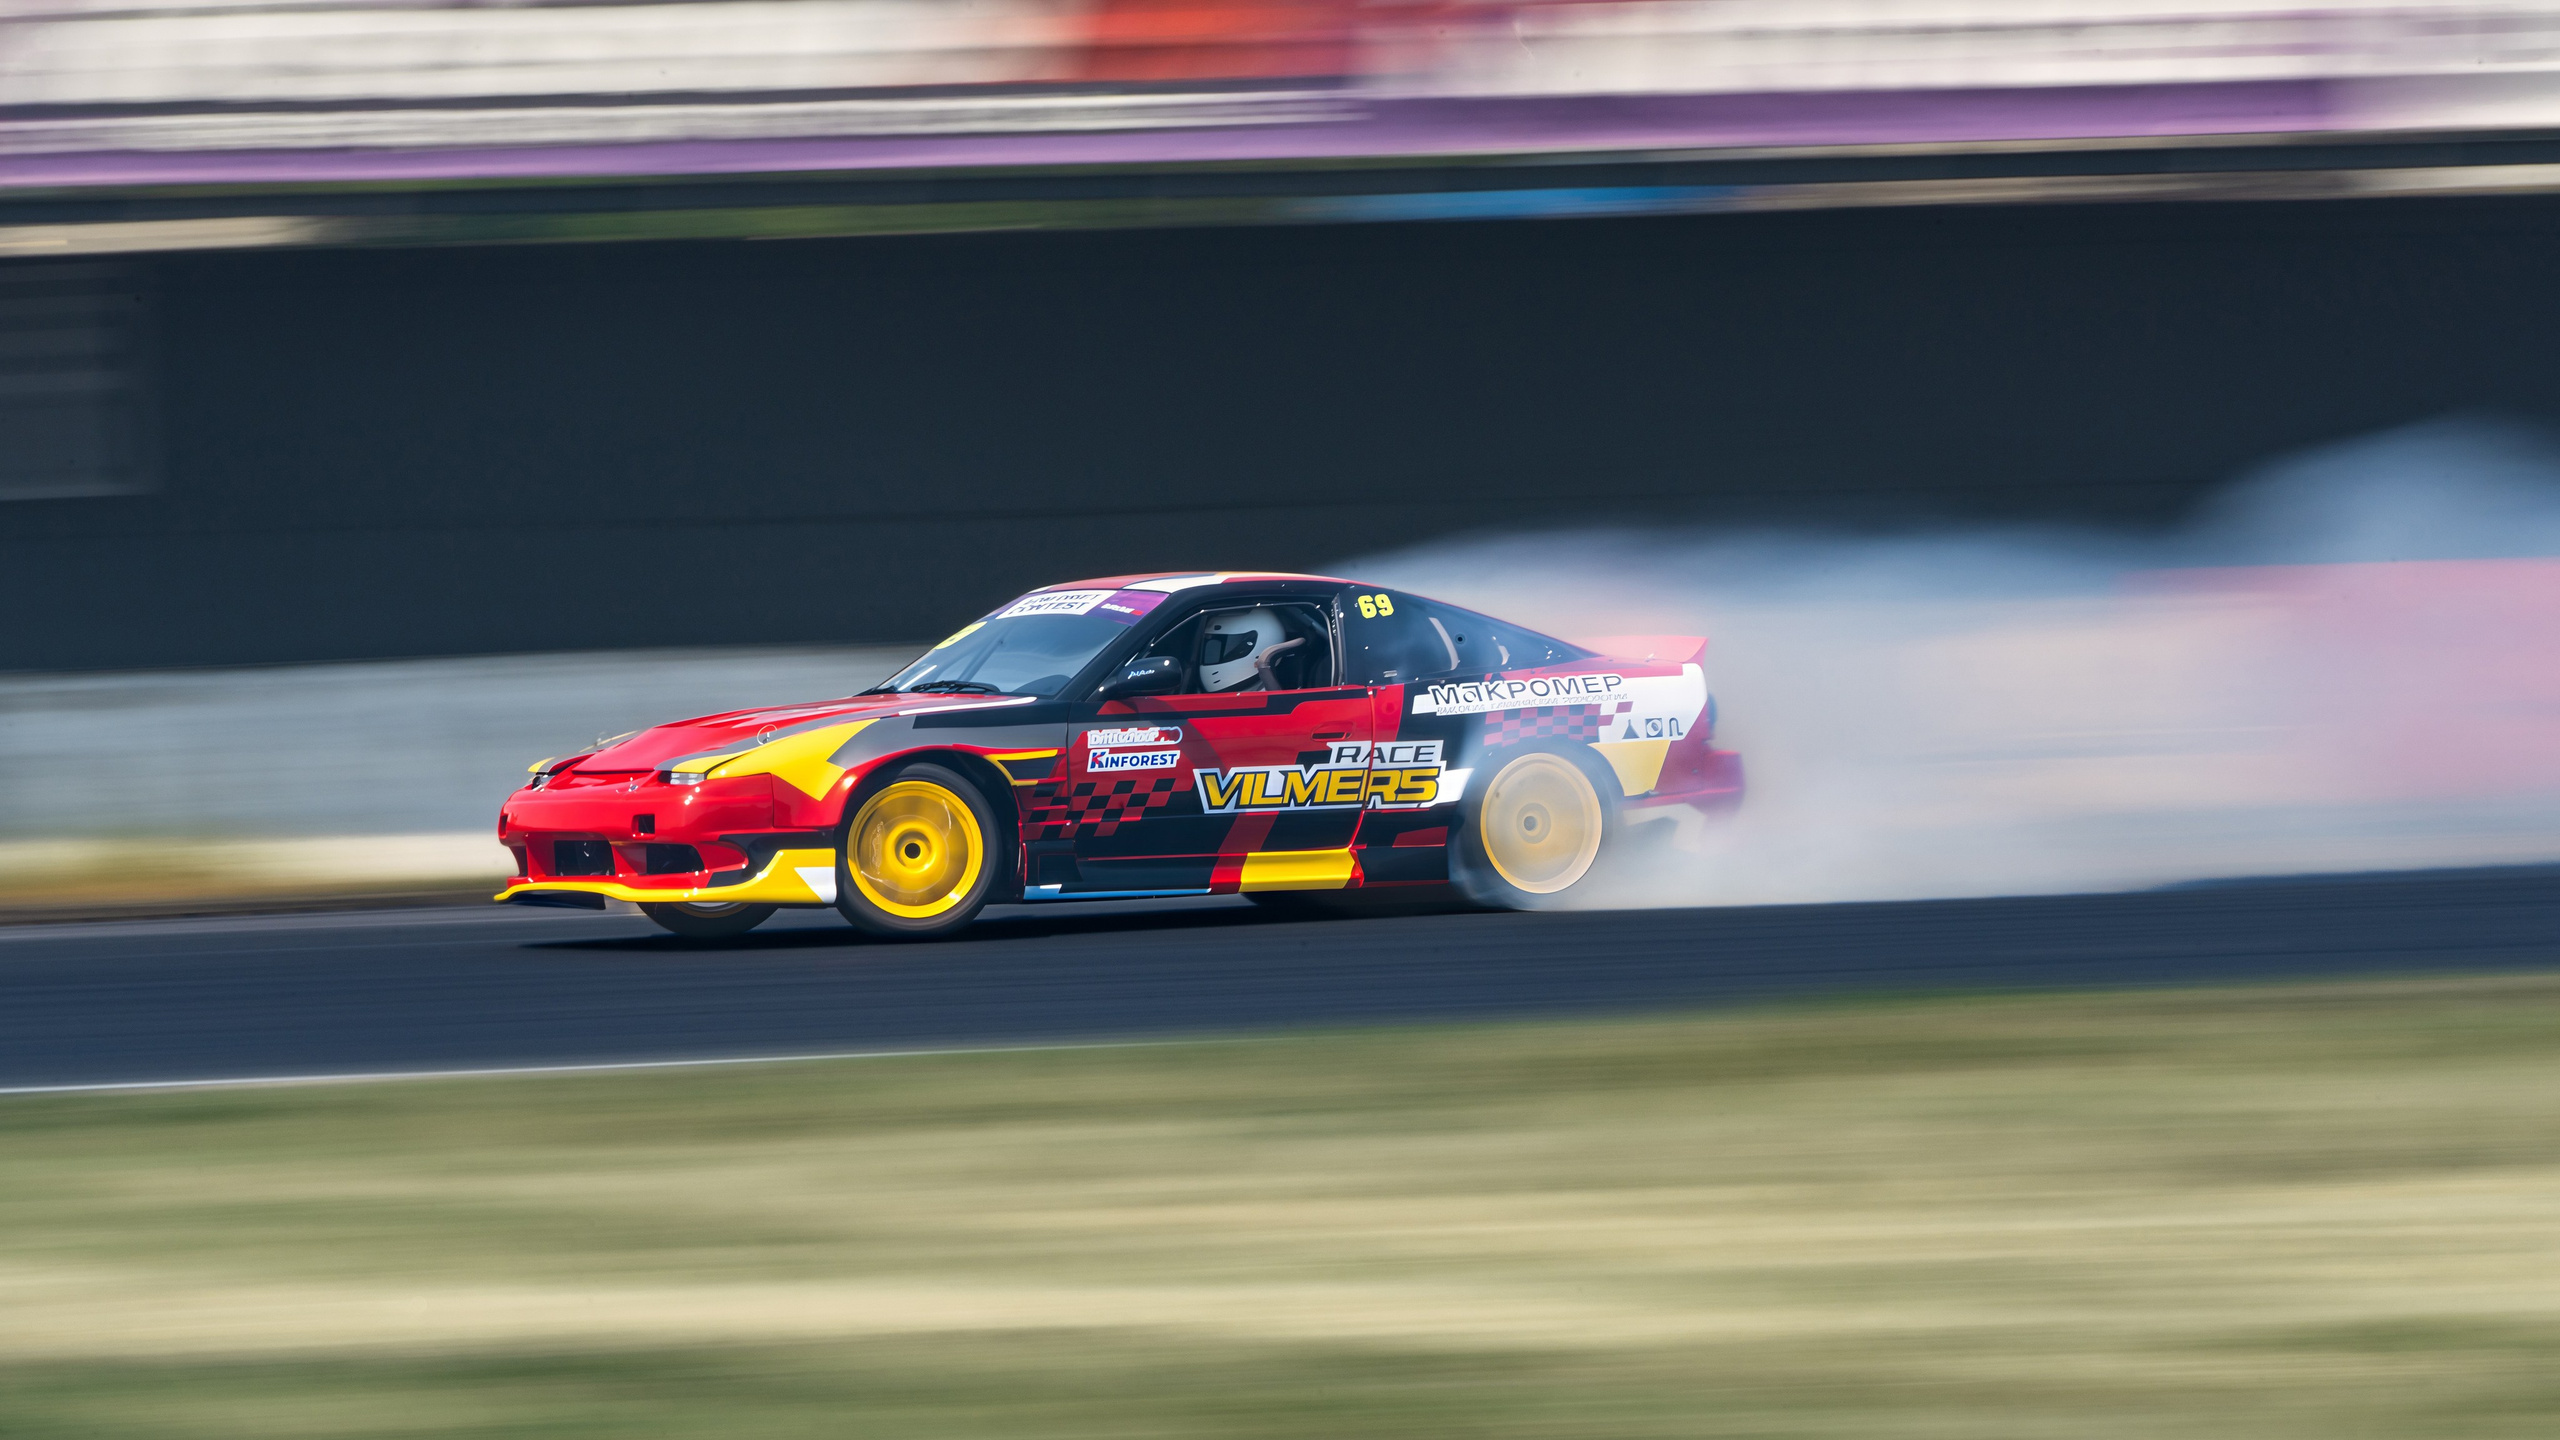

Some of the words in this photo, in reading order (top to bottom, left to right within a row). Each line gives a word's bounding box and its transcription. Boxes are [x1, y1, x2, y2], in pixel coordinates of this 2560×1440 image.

[1358, 594, 1394, 618] 69
[1091, 751, 1177, 768] KINFOREST
[1335, 745, 1436, 763] RACE
[1201, 767, 1440, 808] VILMERS
